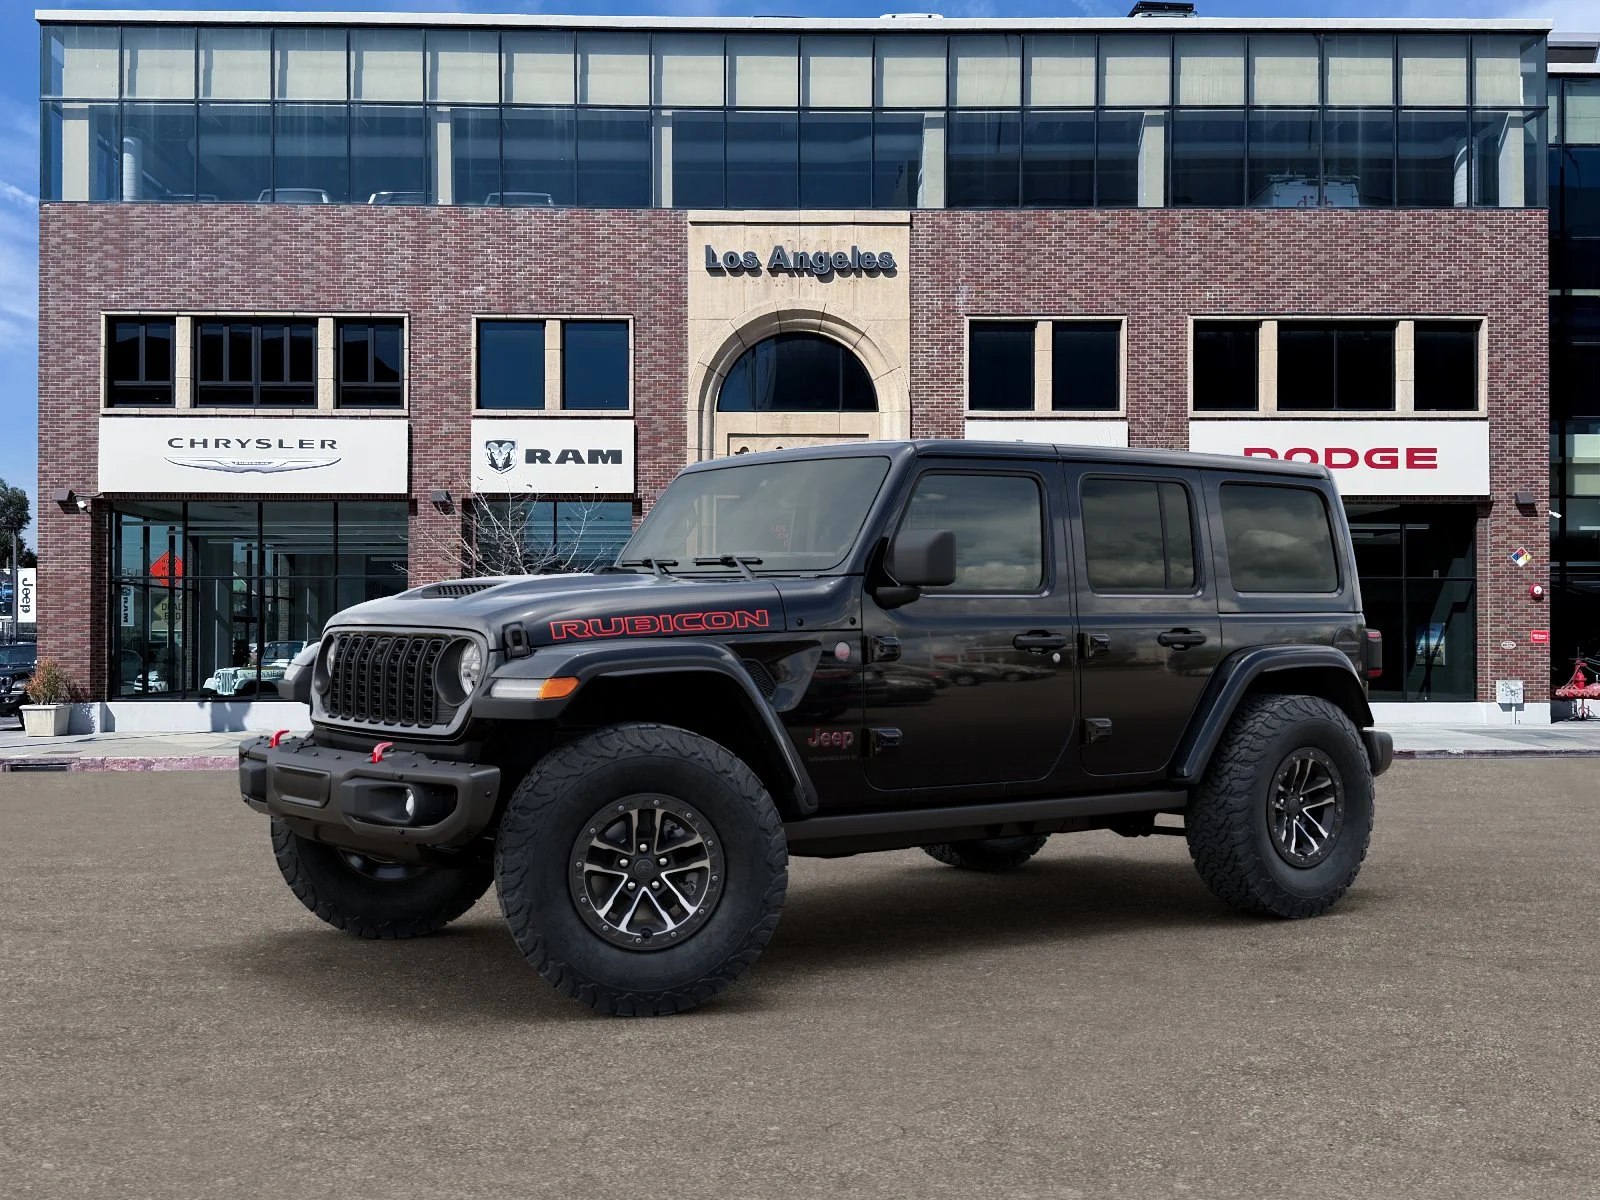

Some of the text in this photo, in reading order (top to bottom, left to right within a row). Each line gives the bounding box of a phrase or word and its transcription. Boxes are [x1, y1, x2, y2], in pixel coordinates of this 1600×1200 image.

[705, 244, 895, 275] Los Angeles
[167, 437, 338, 450] CHRYSLER
[525, 448, 623, 465] RAM
[20, 577, 33, 613] Jeep
[164, 612, 181, 620] ED
[550, 609, 769, 640] RUBICON
[807, 728, 855, 750] Jeep
